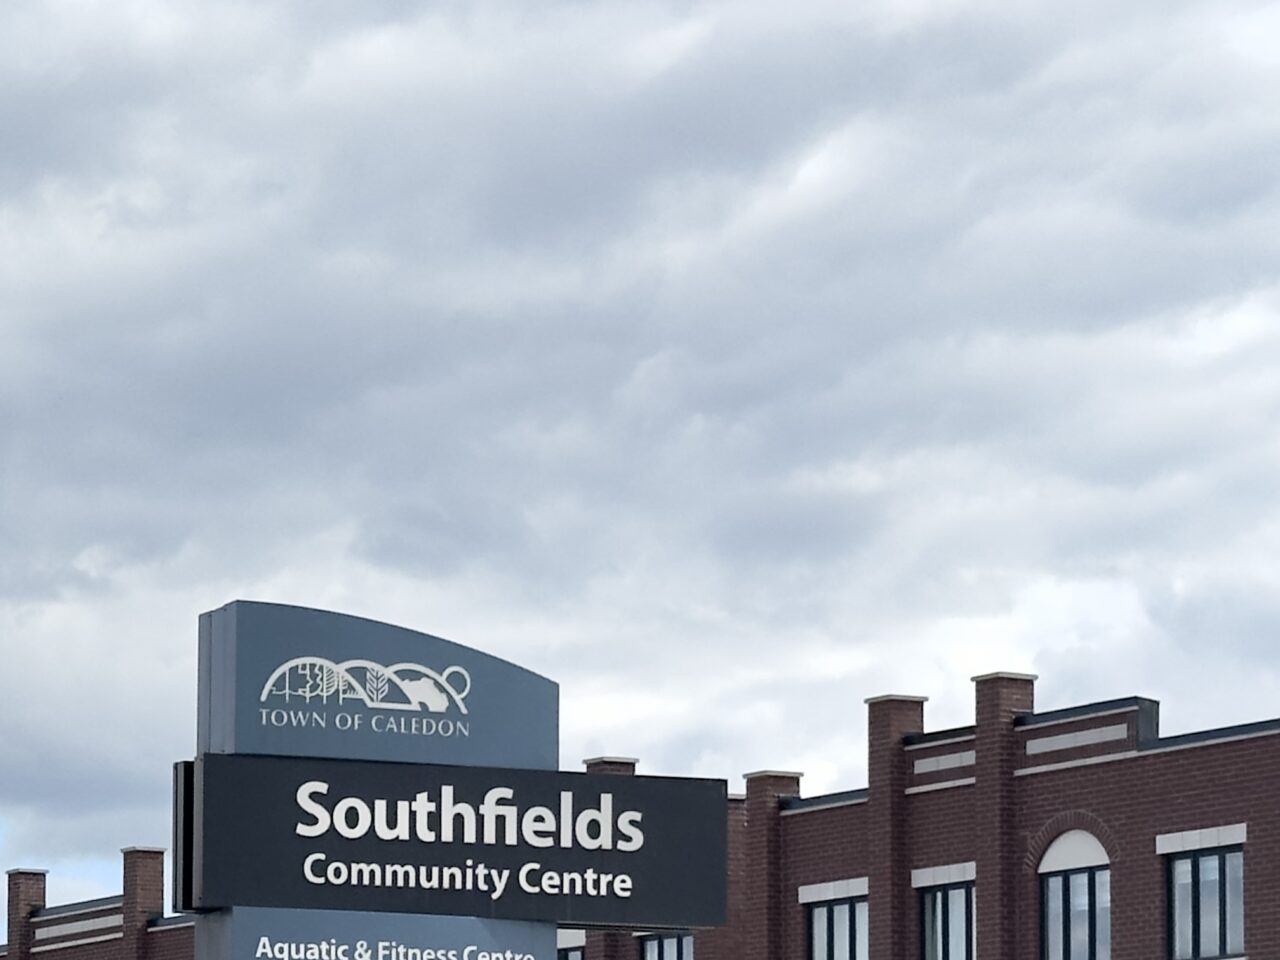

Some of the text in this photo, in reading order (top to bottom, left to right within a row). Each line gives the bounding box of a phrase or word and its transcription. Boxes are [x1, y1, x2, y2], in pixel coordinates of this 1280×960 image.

[259, 708, 470, 737] TOWN OF CALEDON
[295, 781, 645, 852] Southfields
[303, 853, 634, 900] Community Centre
